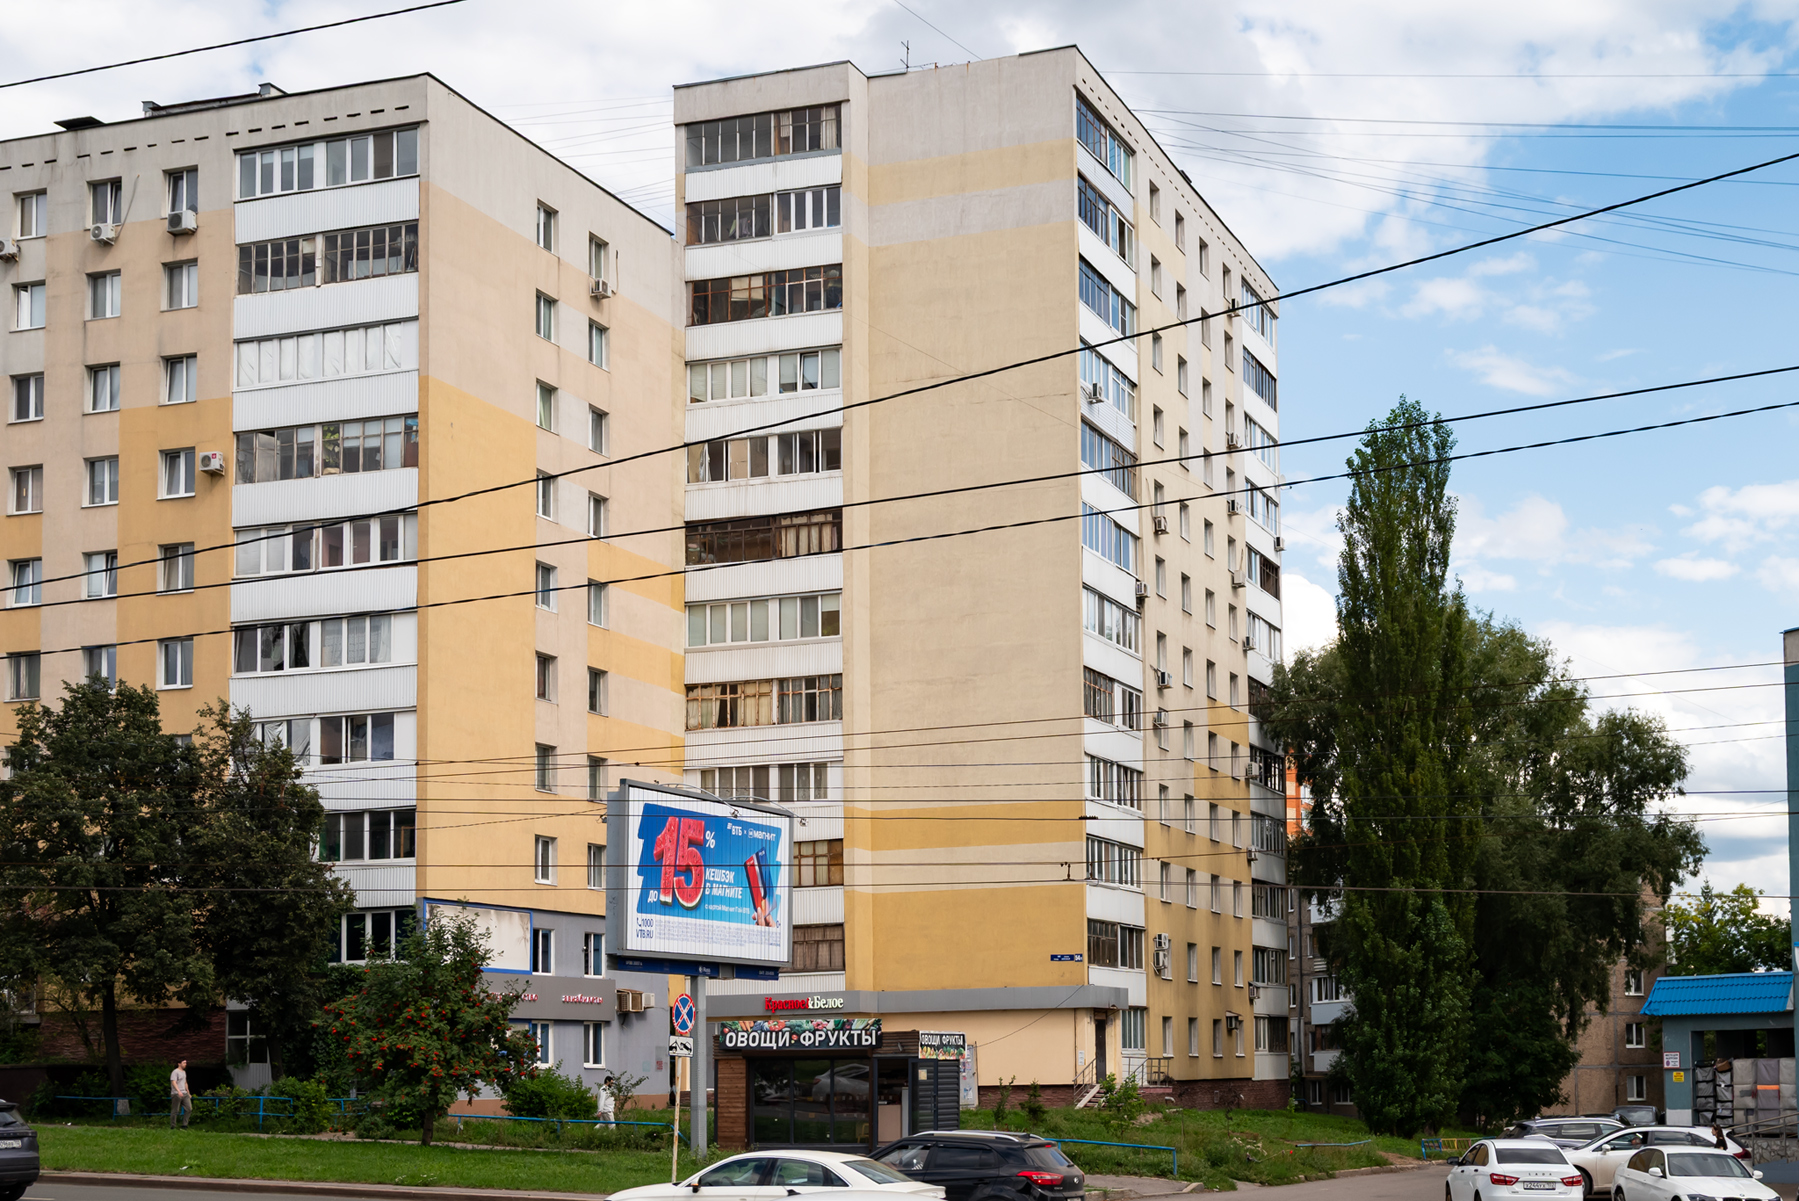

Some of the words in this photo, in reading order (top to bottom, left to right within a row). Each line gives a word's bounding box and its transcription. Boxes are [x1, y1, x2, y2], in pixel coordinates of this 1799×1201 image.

[731, 826, 743, 836] ВТБ
[705, 868, 735, 883] КЕШБЭК
[705, 883, 711, 895] В
[712, 884, 743, 899] МАГНИТЕ
[641, 918, 654, 927] 1000
[636, 929, 654, 938] VTB.RU
[725, 1030, 790, 1050] ОВОЩИ
[800, 1028, 877, 1047] ФРУКТЫ
[921, 1034, 940, 1046] ОВОЩИ
[942, 1035, 963, 1046] ФРУКТЫ
